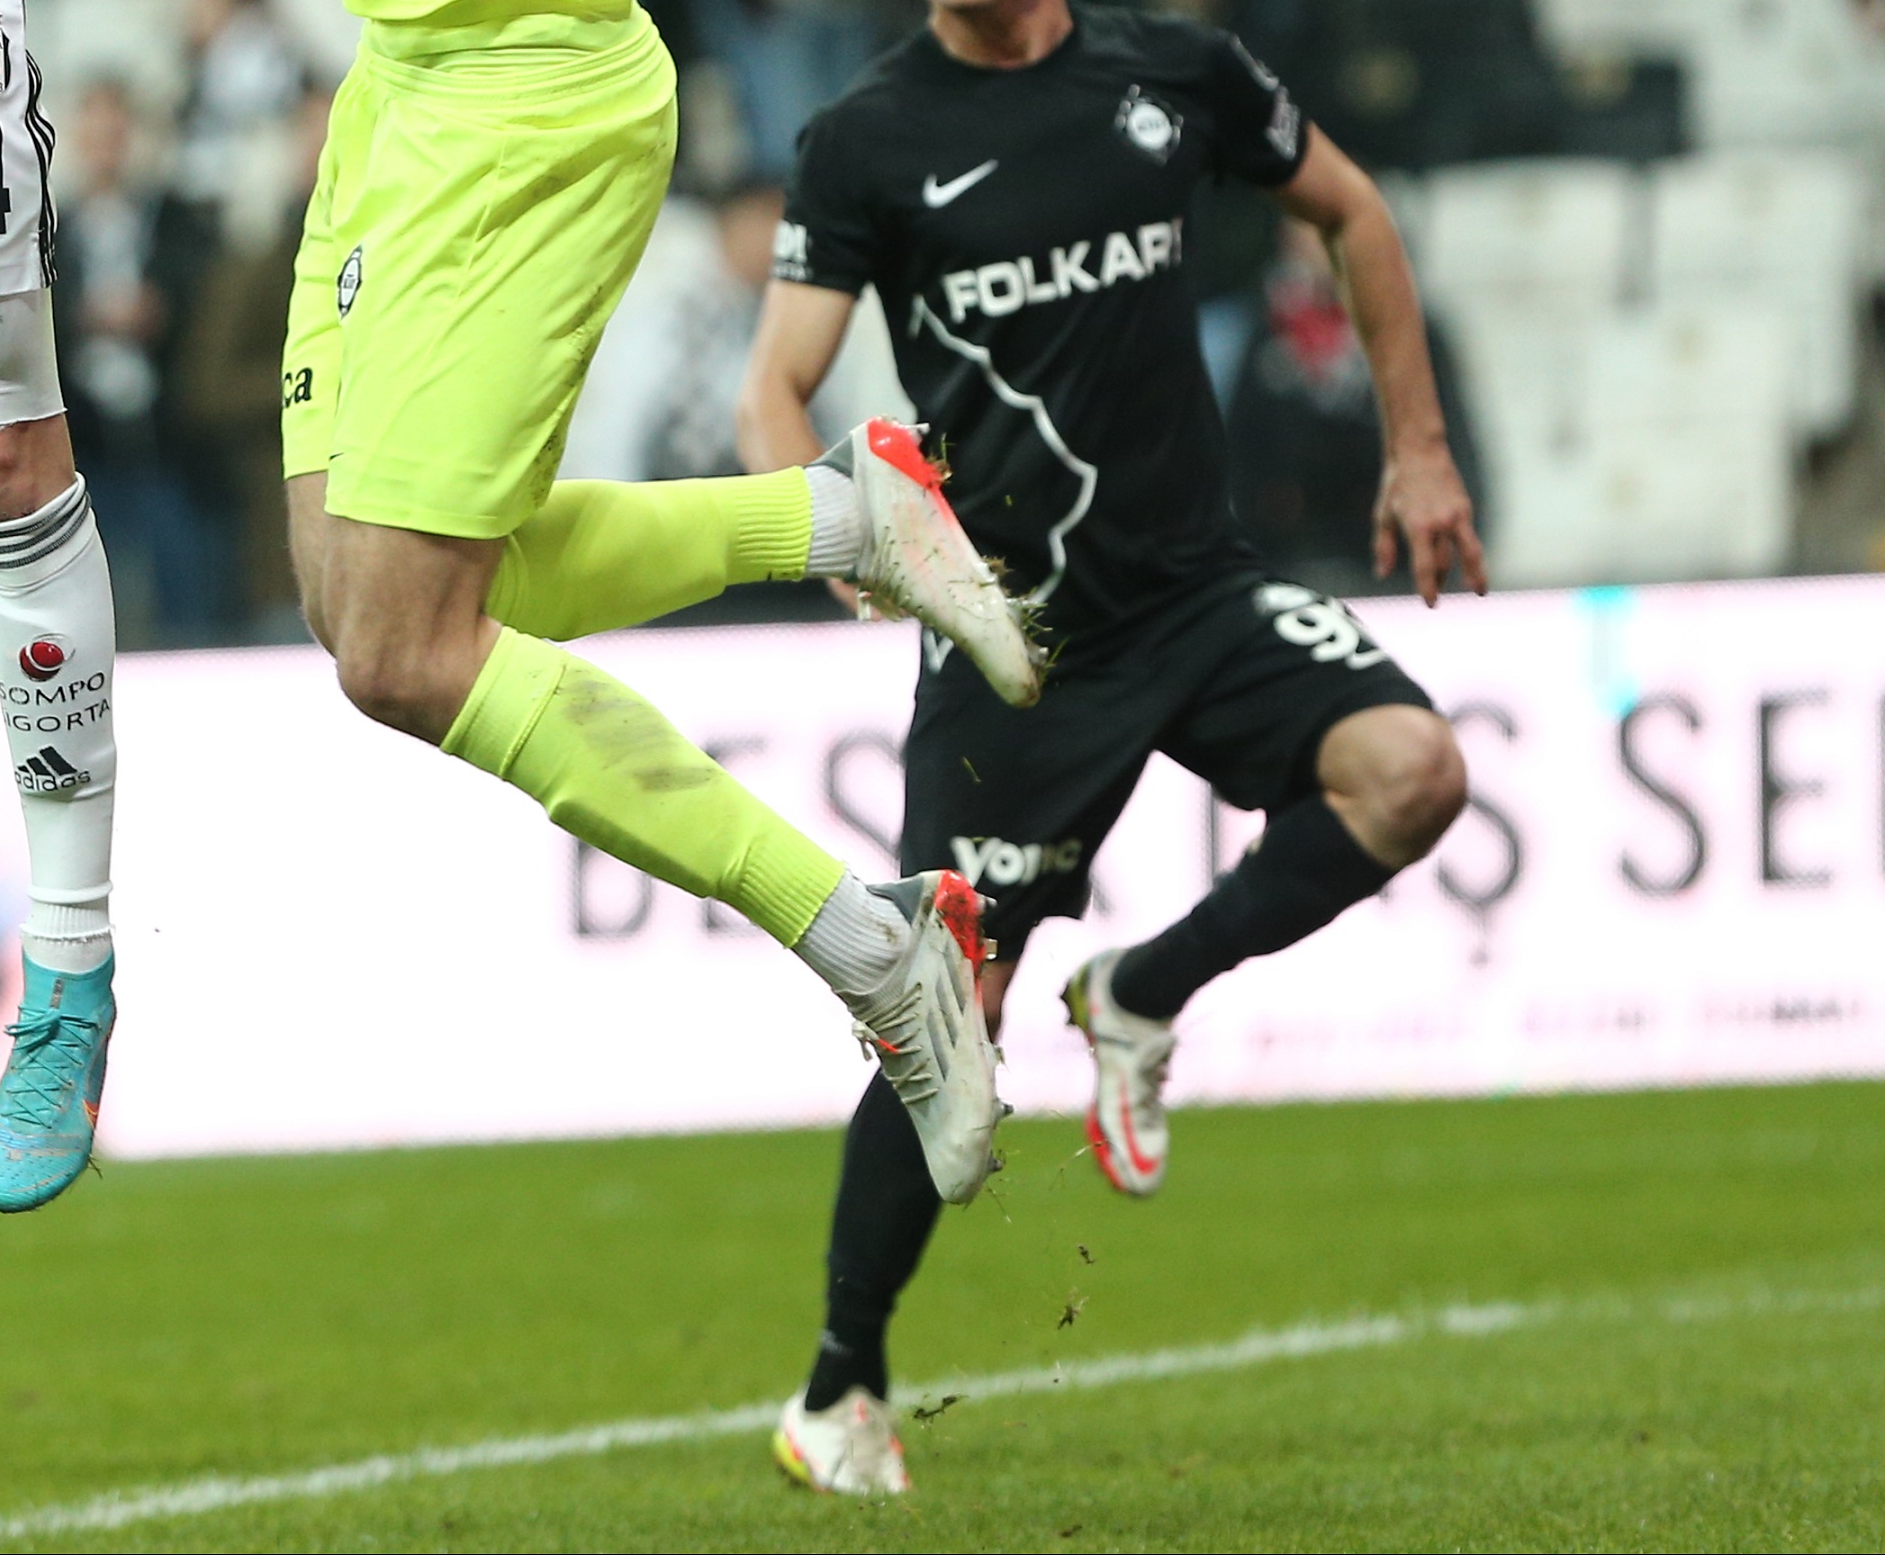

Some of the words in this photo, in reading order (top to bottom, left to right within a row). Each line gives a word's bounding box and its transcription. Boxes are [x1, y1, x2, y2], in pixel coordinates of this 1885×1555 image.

[942, 219, 1183, 324] FOLKAR
[5, 698, 111, 733] IGORTA
[1616, 684, 1885, 896] SE
